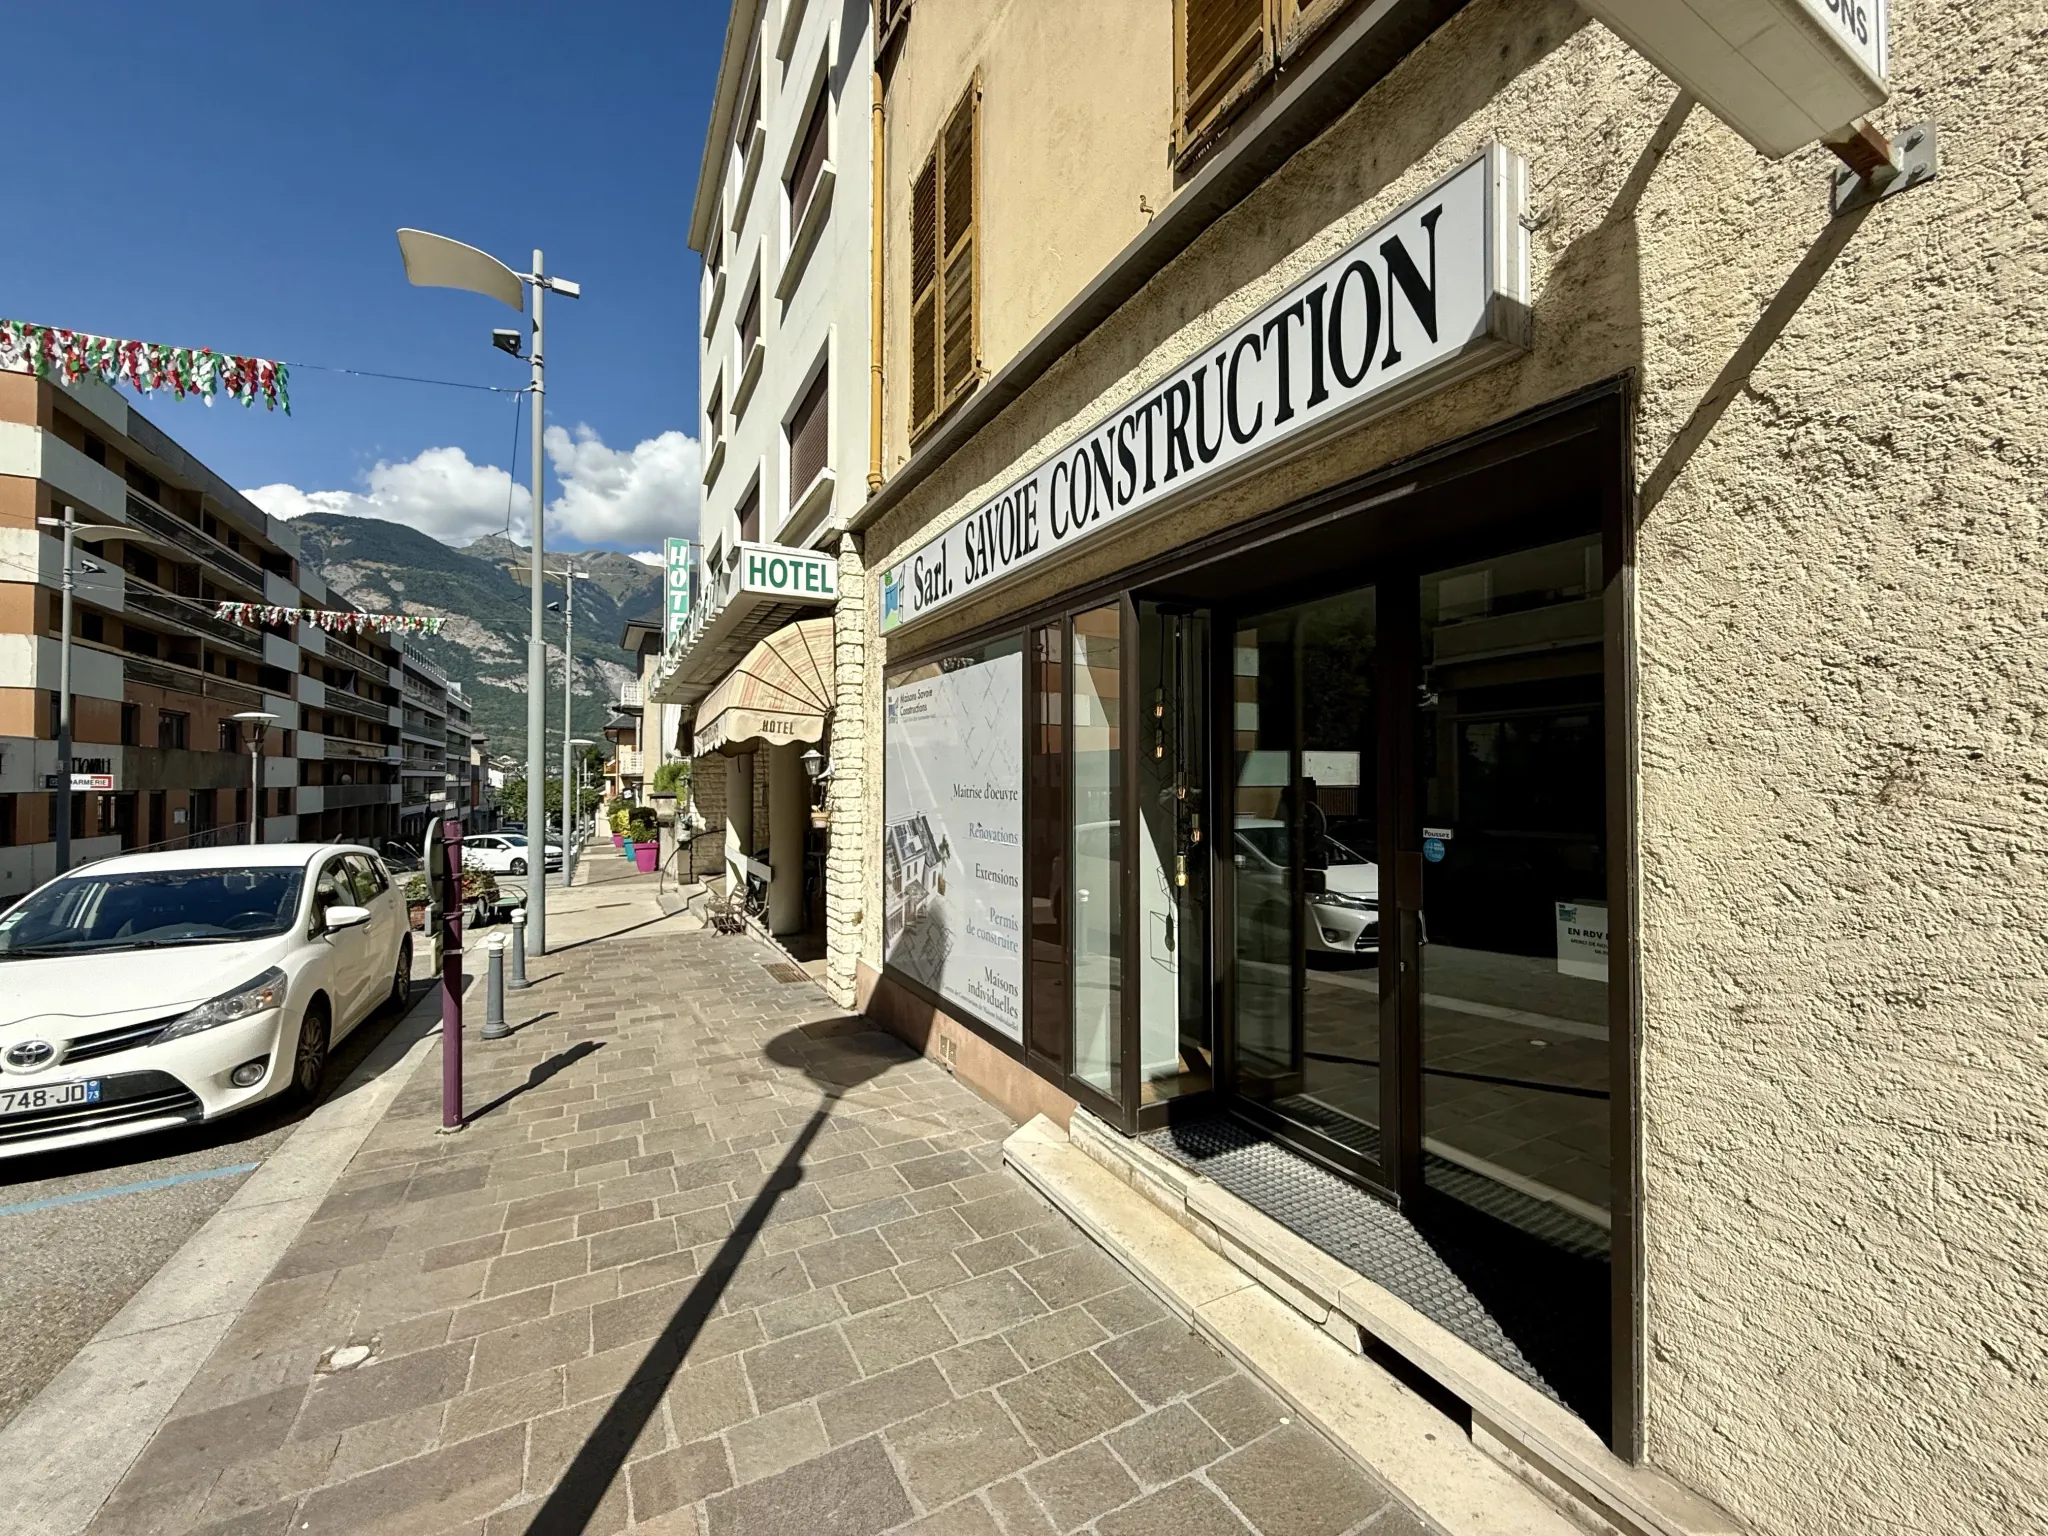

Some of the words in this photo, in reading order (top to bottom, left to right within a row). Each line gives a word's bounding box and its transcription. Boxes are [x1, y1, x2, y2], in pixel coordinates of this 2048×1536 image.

[914, 538, 953, 611] Sarl.
[965, 479, 1039, 585] SAVOIE
[1049, 203, 1443, 540] CONSTRUCTION
[750, 555, 834, 594] HOTEL
[762, 719, 795, 735] HOTEL
[1424, 829, 1450, 838] Poussez
[975, 863, 1019, 887] Extensions
[990, 906, 1019, 931] Permis
[966, 918, 976, 935] de
[977, 928, 1019, 953] construire
[1568, 927, 1580, 936] EN
[1583, 929, 1603, 940] RDV
[984, 966, 1019, 997] Maisons
[967, 978, 1019, 1019] individuelles
[88, 1090, 99, 1100] 73
